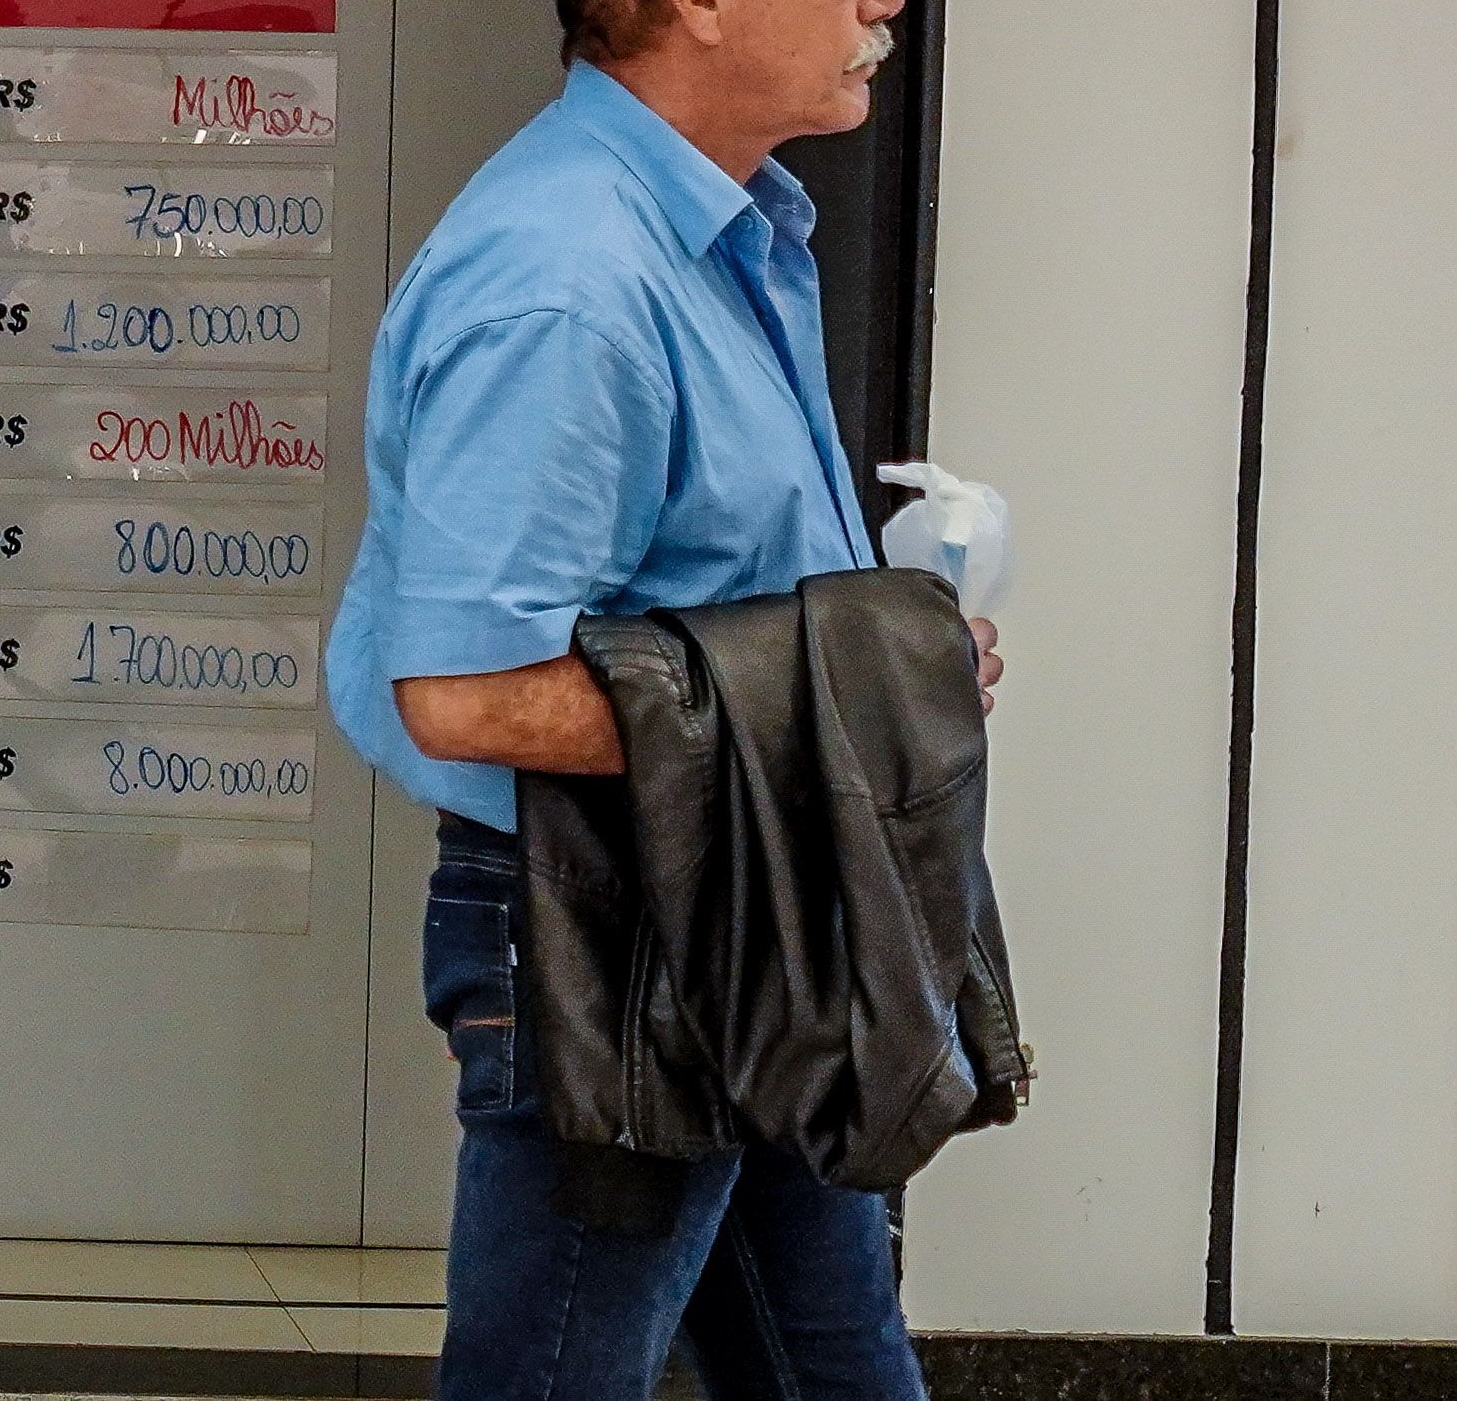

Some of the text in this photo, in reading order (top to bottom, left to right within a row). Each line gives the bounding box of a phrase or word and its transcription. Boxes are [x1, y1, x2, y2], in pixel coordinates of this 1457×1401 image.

[172, 73, 334, 137] Milhões
[89, 410, 172, 462] 200
[177, 399, 324, 472] Milhões
